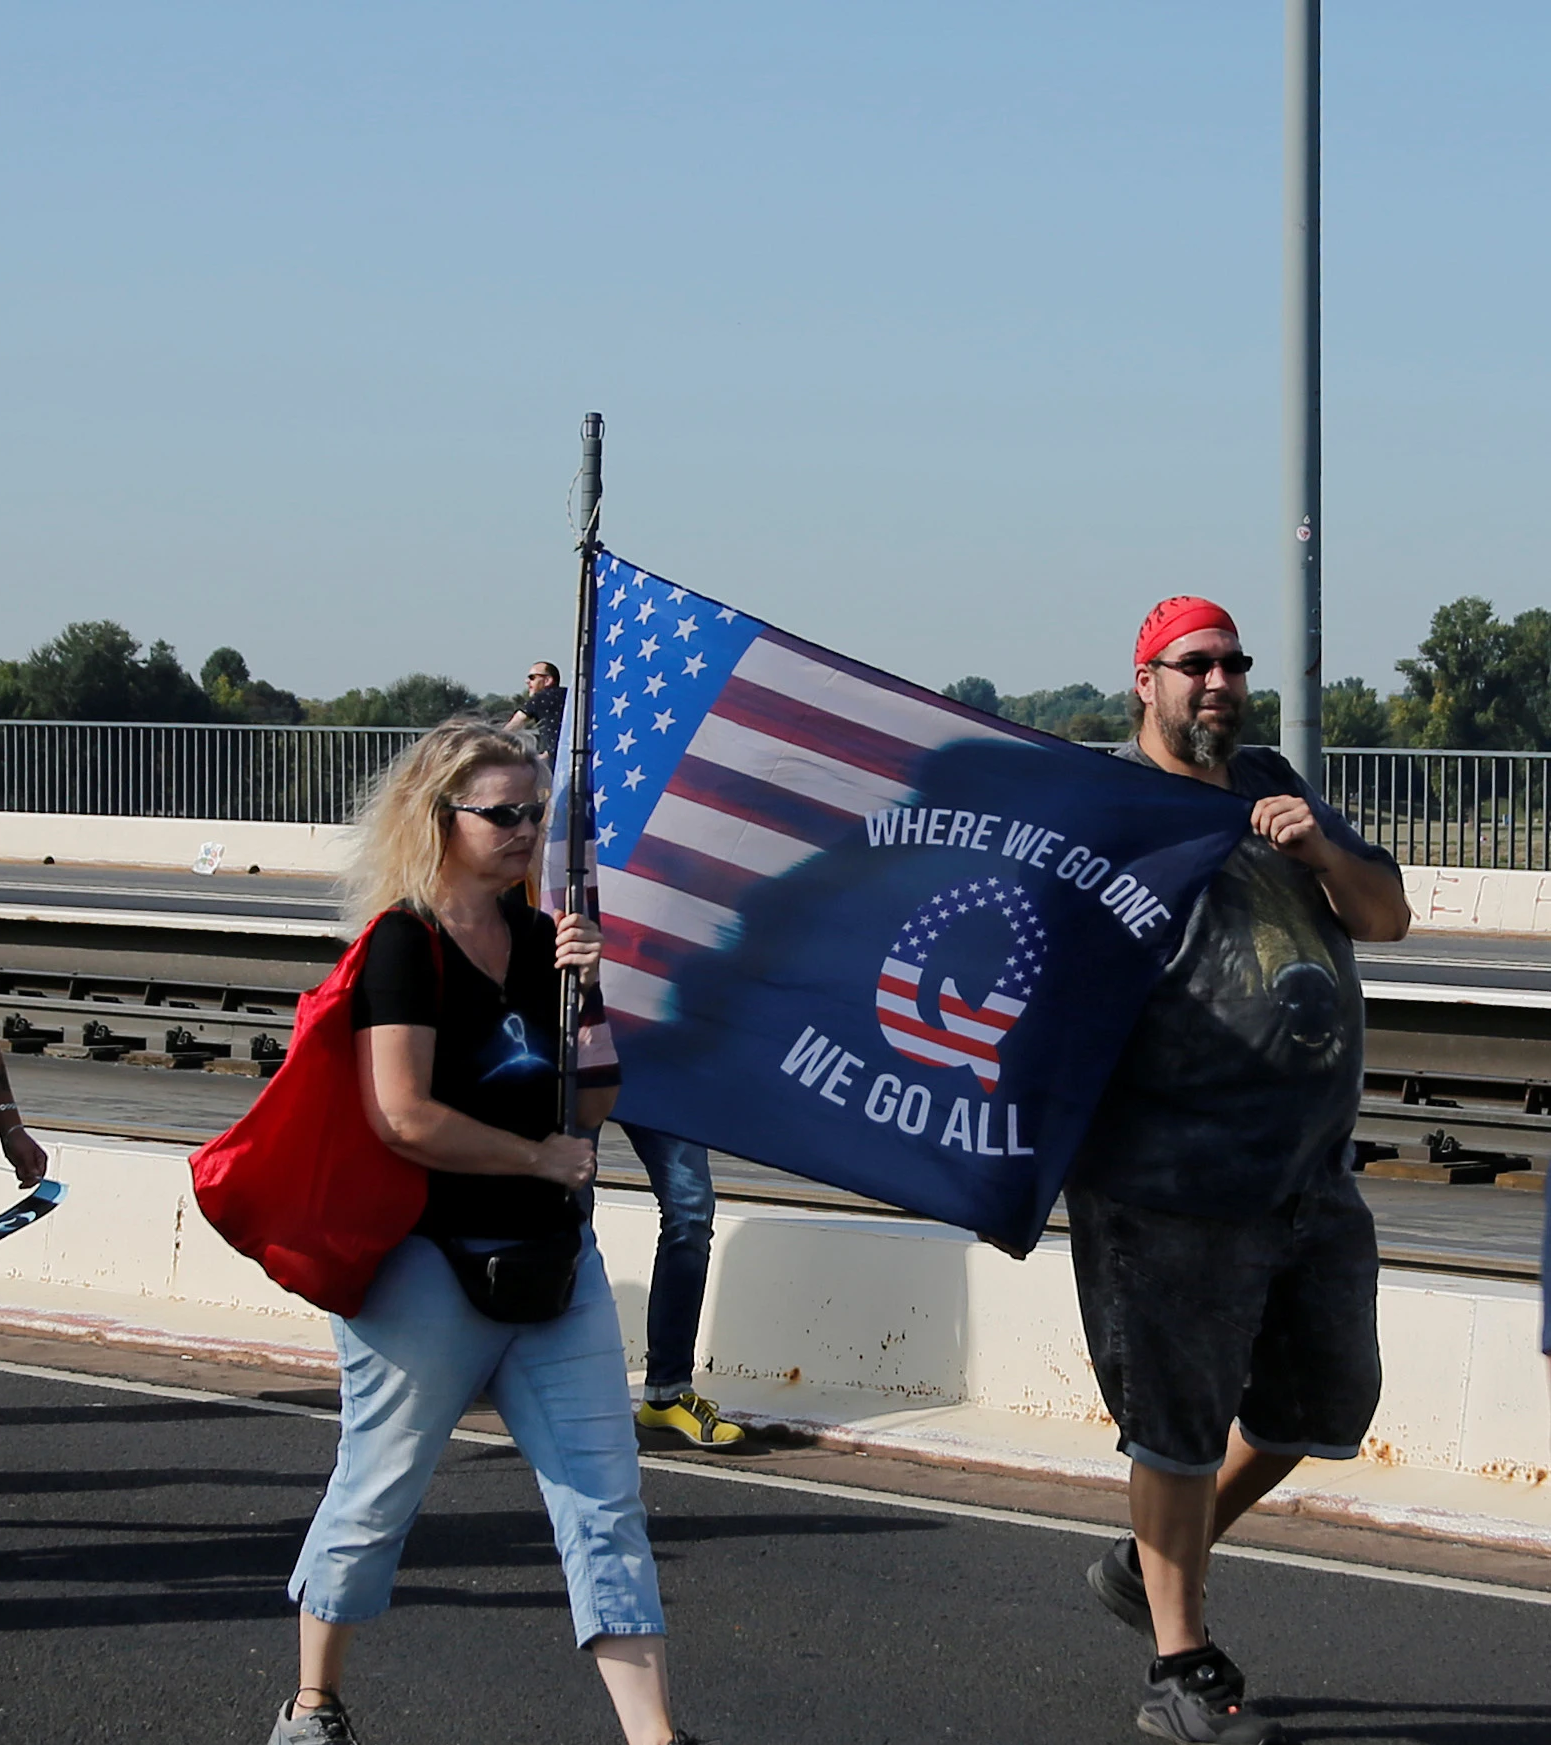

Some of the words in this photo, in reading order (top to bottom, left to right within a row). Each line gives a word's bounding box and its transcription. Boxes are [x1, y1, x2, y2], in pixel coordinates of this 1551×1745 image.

[865, 807, 1002, 851] WHERE
[1001, 820, 1065, 869] WE
[1056, 845, 1110, 890] GO
[1100, 873, 1172, 939] ONE
[876, 873, 1049, 1095] Q
[780, 1025, 865, 1106] WE
[864, 1073, 932, 1135] GO
[940, 1097, 1034, 1156] ALL
